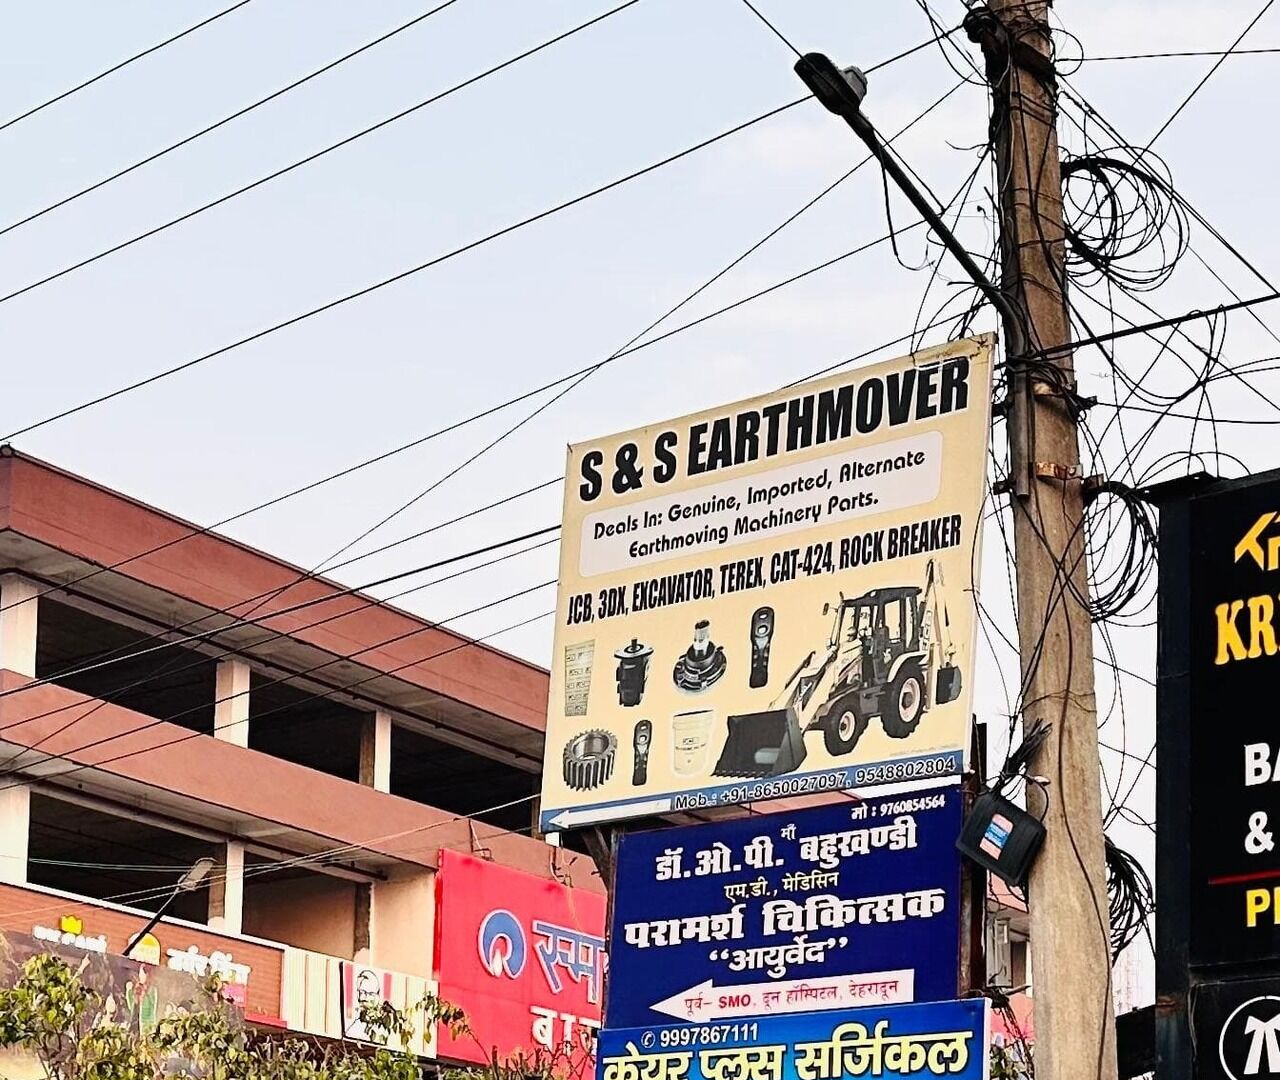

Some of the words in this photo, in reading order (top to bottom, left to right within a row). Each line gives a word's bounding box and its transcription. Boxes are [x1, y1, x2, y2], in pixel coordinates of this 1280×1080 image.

[579, 450, 603, 502] S
[611, 443, 644, 492] &
[653, 430, 678, 484] S
[687, 356, 970, 476] EARTHMOVER
[594, 515, 638, 539] Deals
[643, 511, 663, 528] In:
[668, 495, 741, 522] Genuine,
[747, 468, 832, 504] Imported,
[839, 451, 925, 483] Alternate
[629, 525, 729, 558] Earthmoving
[734, 504, 821, 536] Machinery
[827, 491, 879, 515] Parts.
[566, 593, 595, 625] JCB,
[598, 585, 629, 619] 3DX,
[631, 568, 716, 612] EXCAVATOR,
[720, 556, 767, 594] TEREX,
[770, 541, 835, 585] CAT-424,
[839, 530, 885, 570] ROCK
[887, 514, 962, 560] BREAKER
[721, 772, 851, 803] +91-8650027097,
[855, 756, 956, 784] 9548802804
[880, 794, 946, 817] 9760854564
[1243, 810, 1275, 855] &
[625, 903, 745, 949] परामर्श
[762, 887, 945, 935] चिकित्सक
[848, 980, 899, 1003] देहरादून
[660, 1023, 759, 1047] 9997867111
